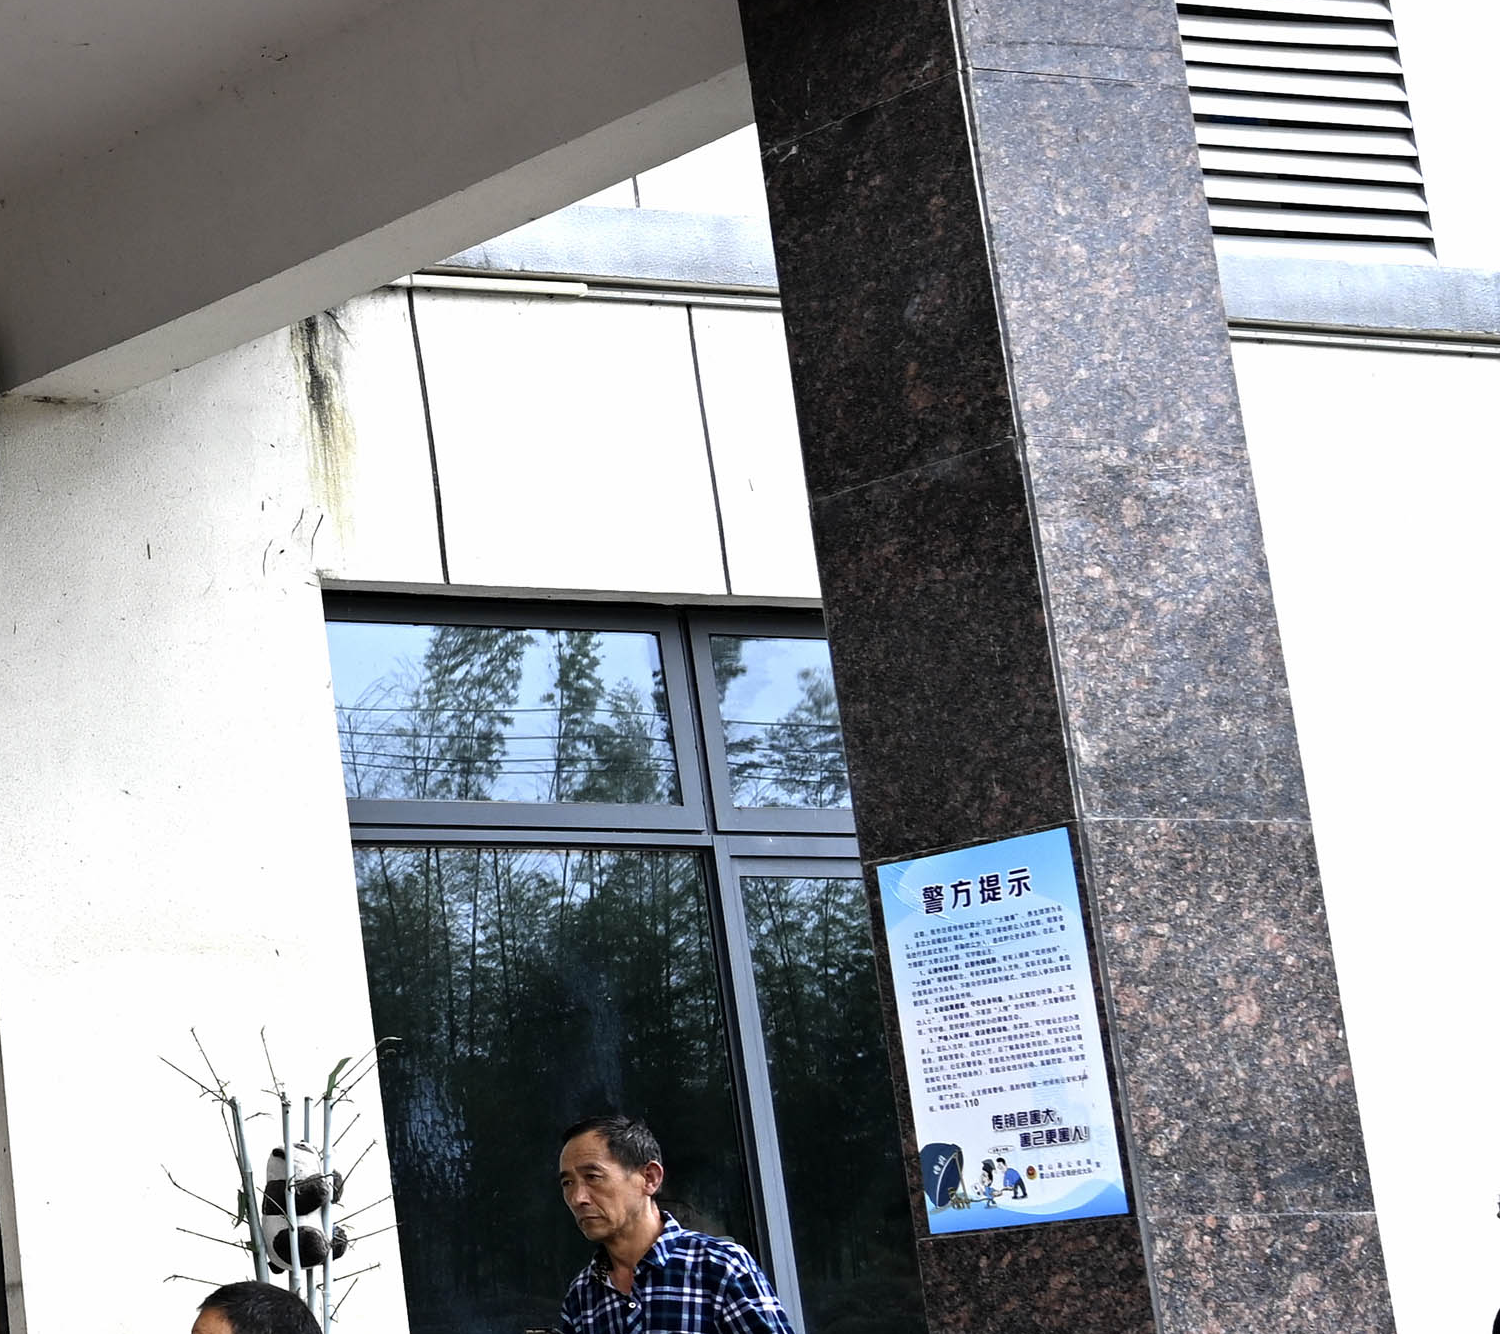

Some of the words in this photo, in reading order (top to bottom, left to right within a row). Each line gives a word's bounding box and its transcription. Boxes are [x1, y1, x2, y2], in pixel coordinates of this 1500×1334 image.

[921, 867, 1032, 915] 警方提示
[963, 1098, 980, 1108] 110
